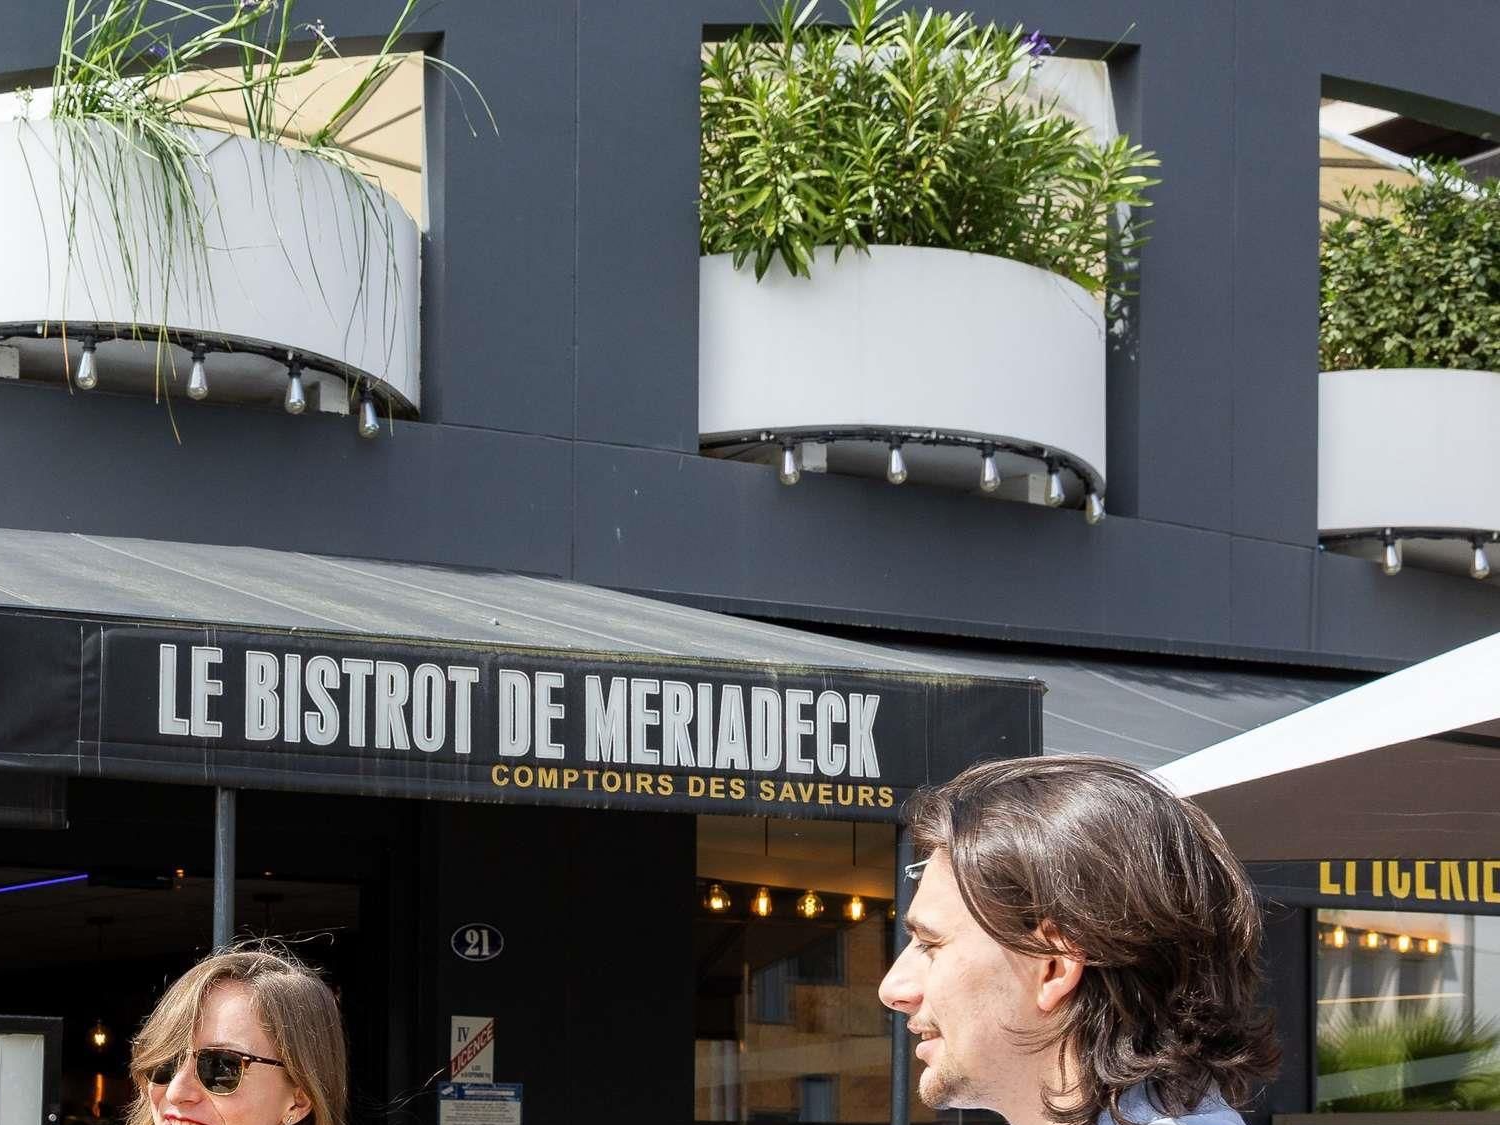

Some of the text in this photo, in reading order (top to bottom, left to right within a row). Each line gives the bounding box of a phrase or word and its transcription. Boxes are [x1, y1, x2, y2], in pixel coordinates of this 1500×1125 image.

[157, 642, 882, 779] LE BISTROT DE MERIADECK
[491, 764, 894, 808] COMPTOIRS DES SAVEURS
[464, 929, 490, 956] 21
[451, 1022, 494, 1073] LICENCE
[457, 1026, 470, 1042] IV
